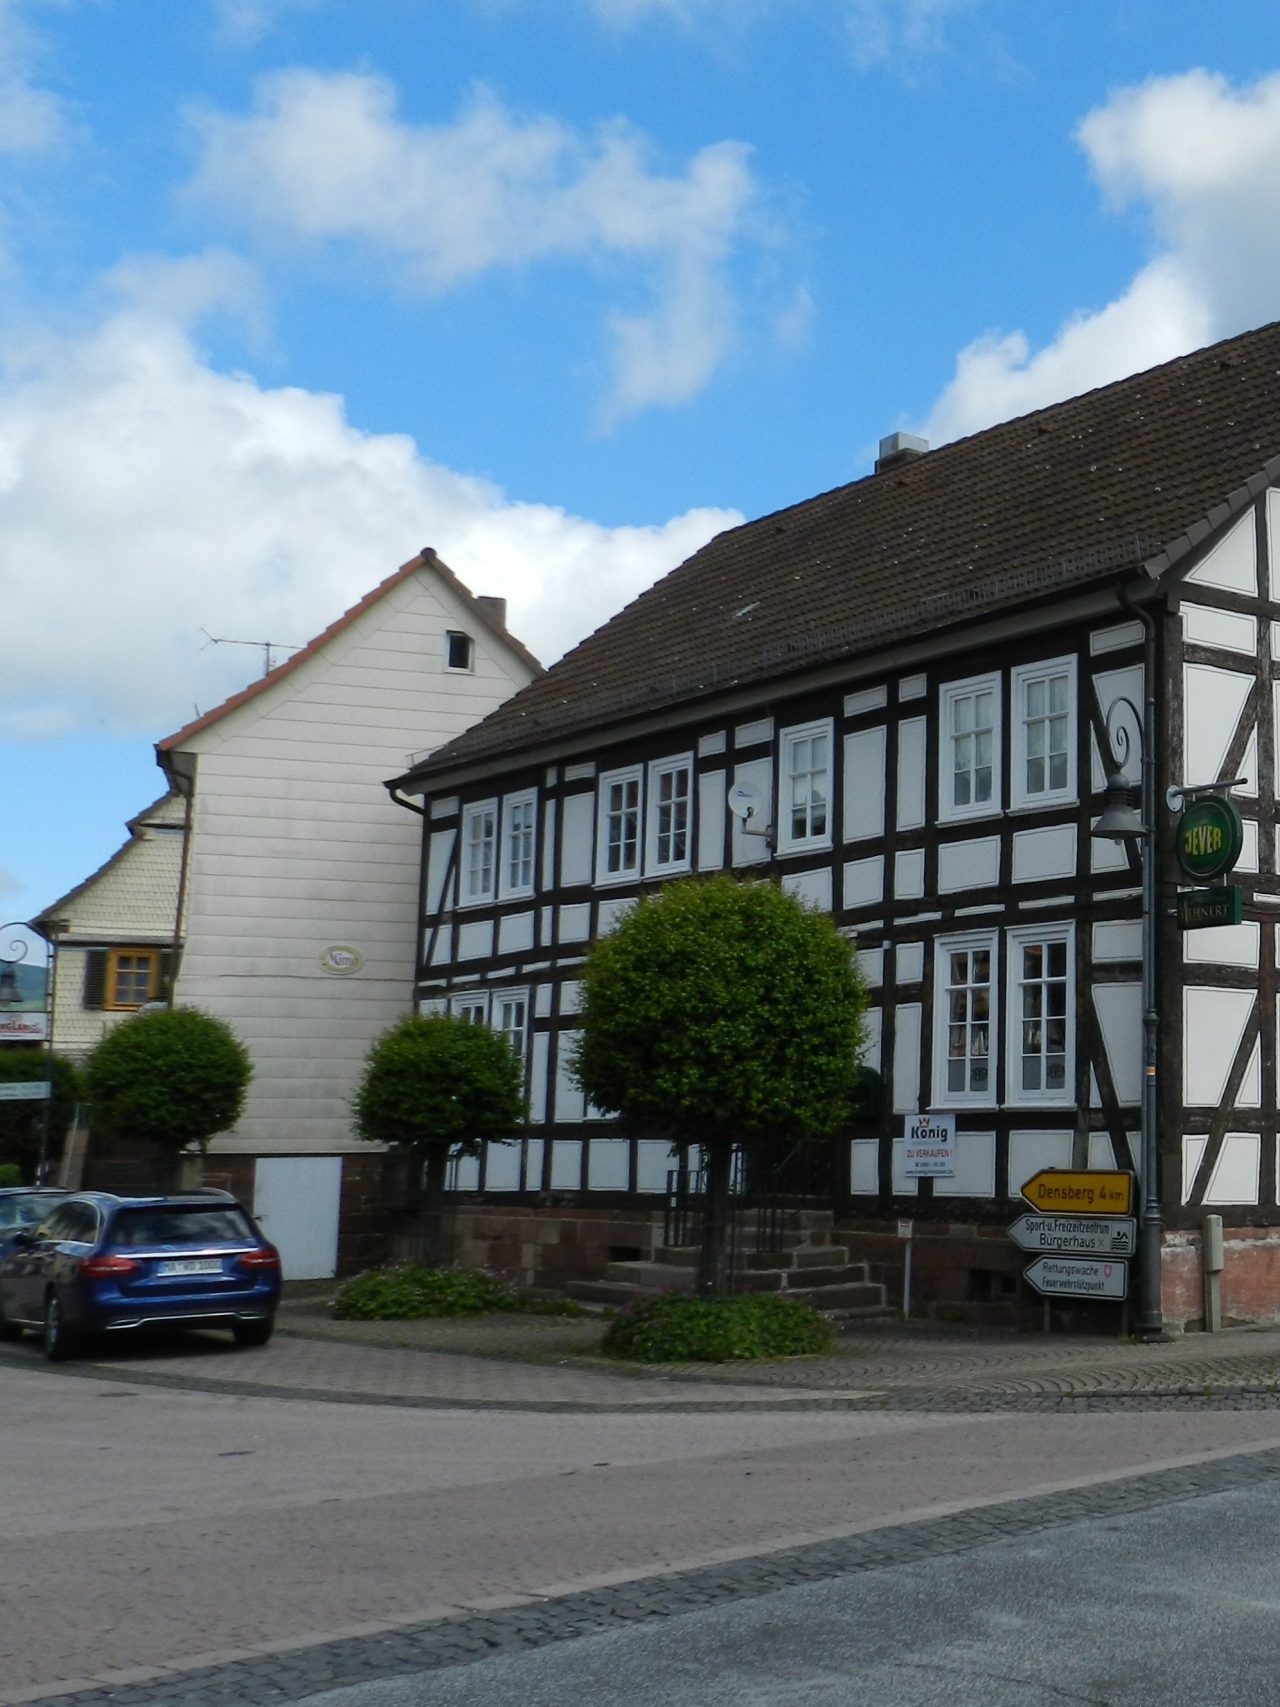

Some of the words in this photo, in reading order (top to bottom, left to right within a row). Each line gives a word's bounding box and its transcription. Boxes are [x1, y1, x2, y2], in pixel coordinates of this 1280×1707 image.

[1184, 825, 1221, 856] JEVER
[906, 1149, 914, 1158] ZU
[1038, 1183, 1095, 1204] Densberg
[1099, 1185, 1107, 1200] 4
[1109, 1190, 1123, 1200] km
[1040, 1233, 1096, 1248] Bürgerhaus
[1042, 1261, 1099, 1277] Rettungswache
